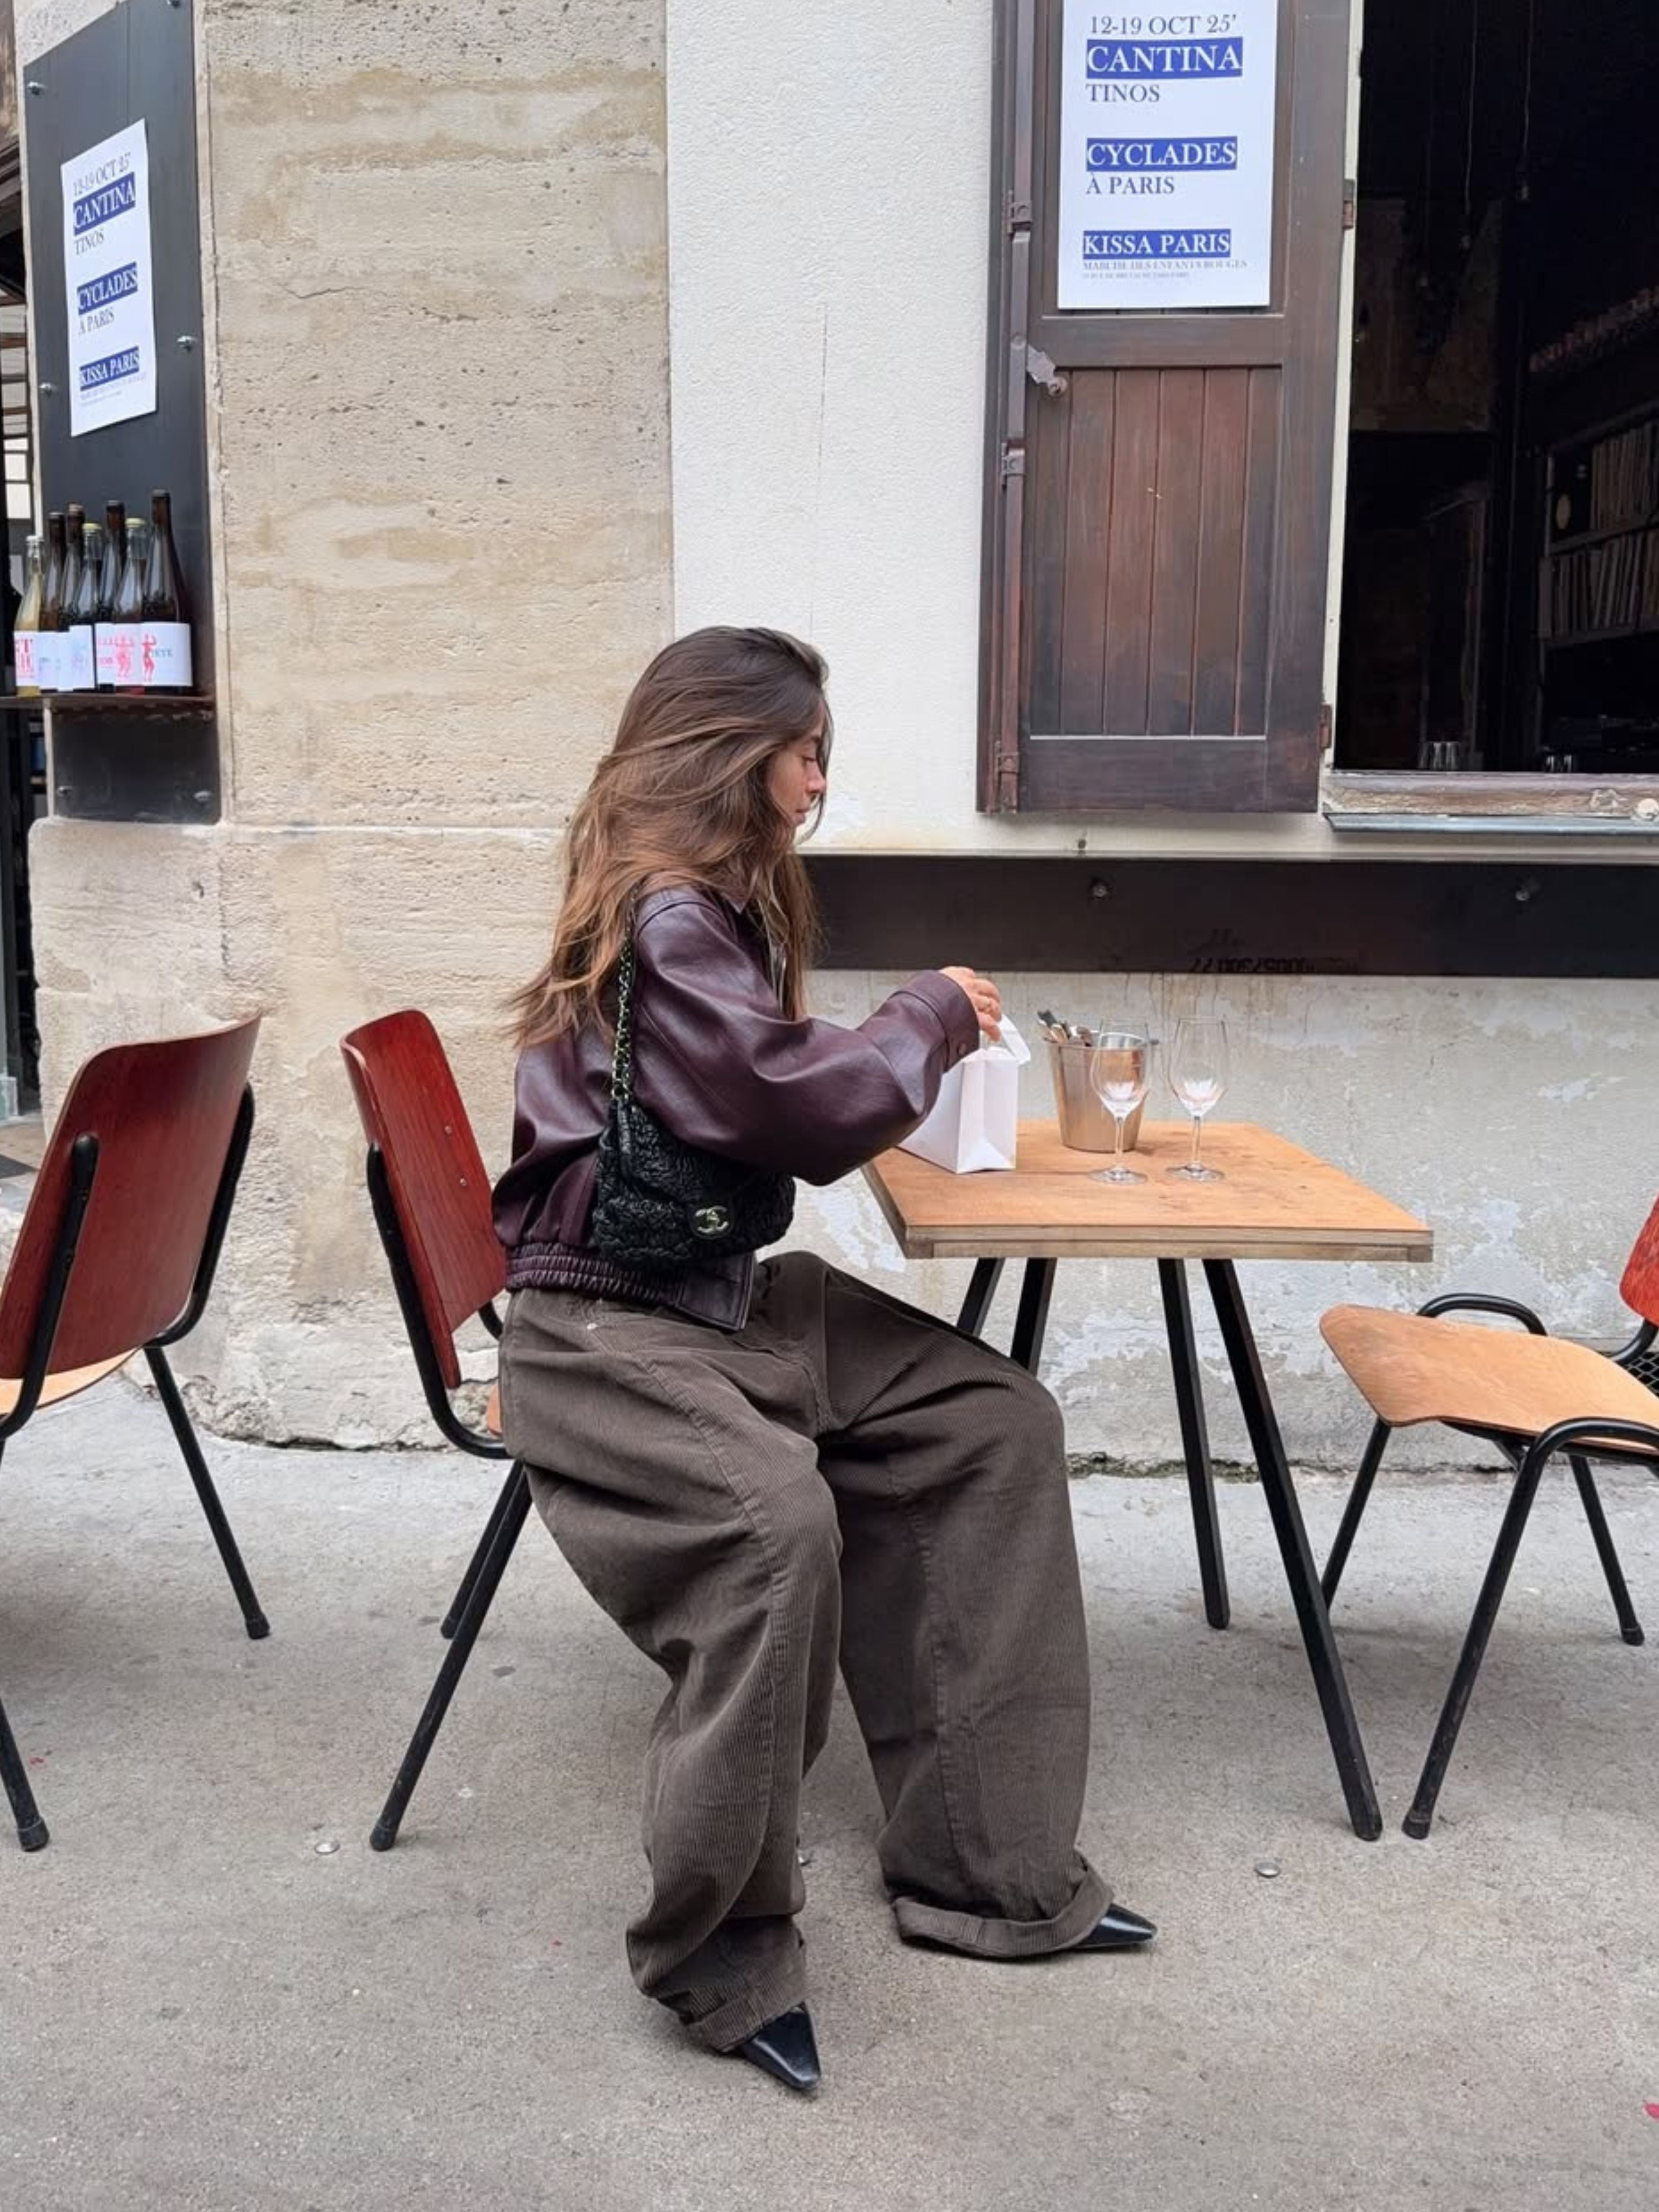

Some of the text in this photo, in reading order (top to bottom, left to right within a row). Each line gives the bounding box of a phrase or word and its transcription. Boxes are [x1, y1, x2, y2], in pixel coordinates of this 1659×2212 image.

[1091, 16, 1142, 35] 12-19
[1149, 16, 1201, 35] OCT
[1088, 45, 1243, 72] CANTINA
[1085, 83, 1160, 102] TINOS
[1088, 142, 1237, 166] CYCLADES
[1085, 171, 1175, 194] À PARIS
[74, 180, 135, 228] CANTINA
[74, 228, 104, 255] TINOS
[1085, 233, 1230, 255] KISSA PARIS
[78, 267, 137, 309] CYCLADES
[110, 351, 139, 378] PARIS
